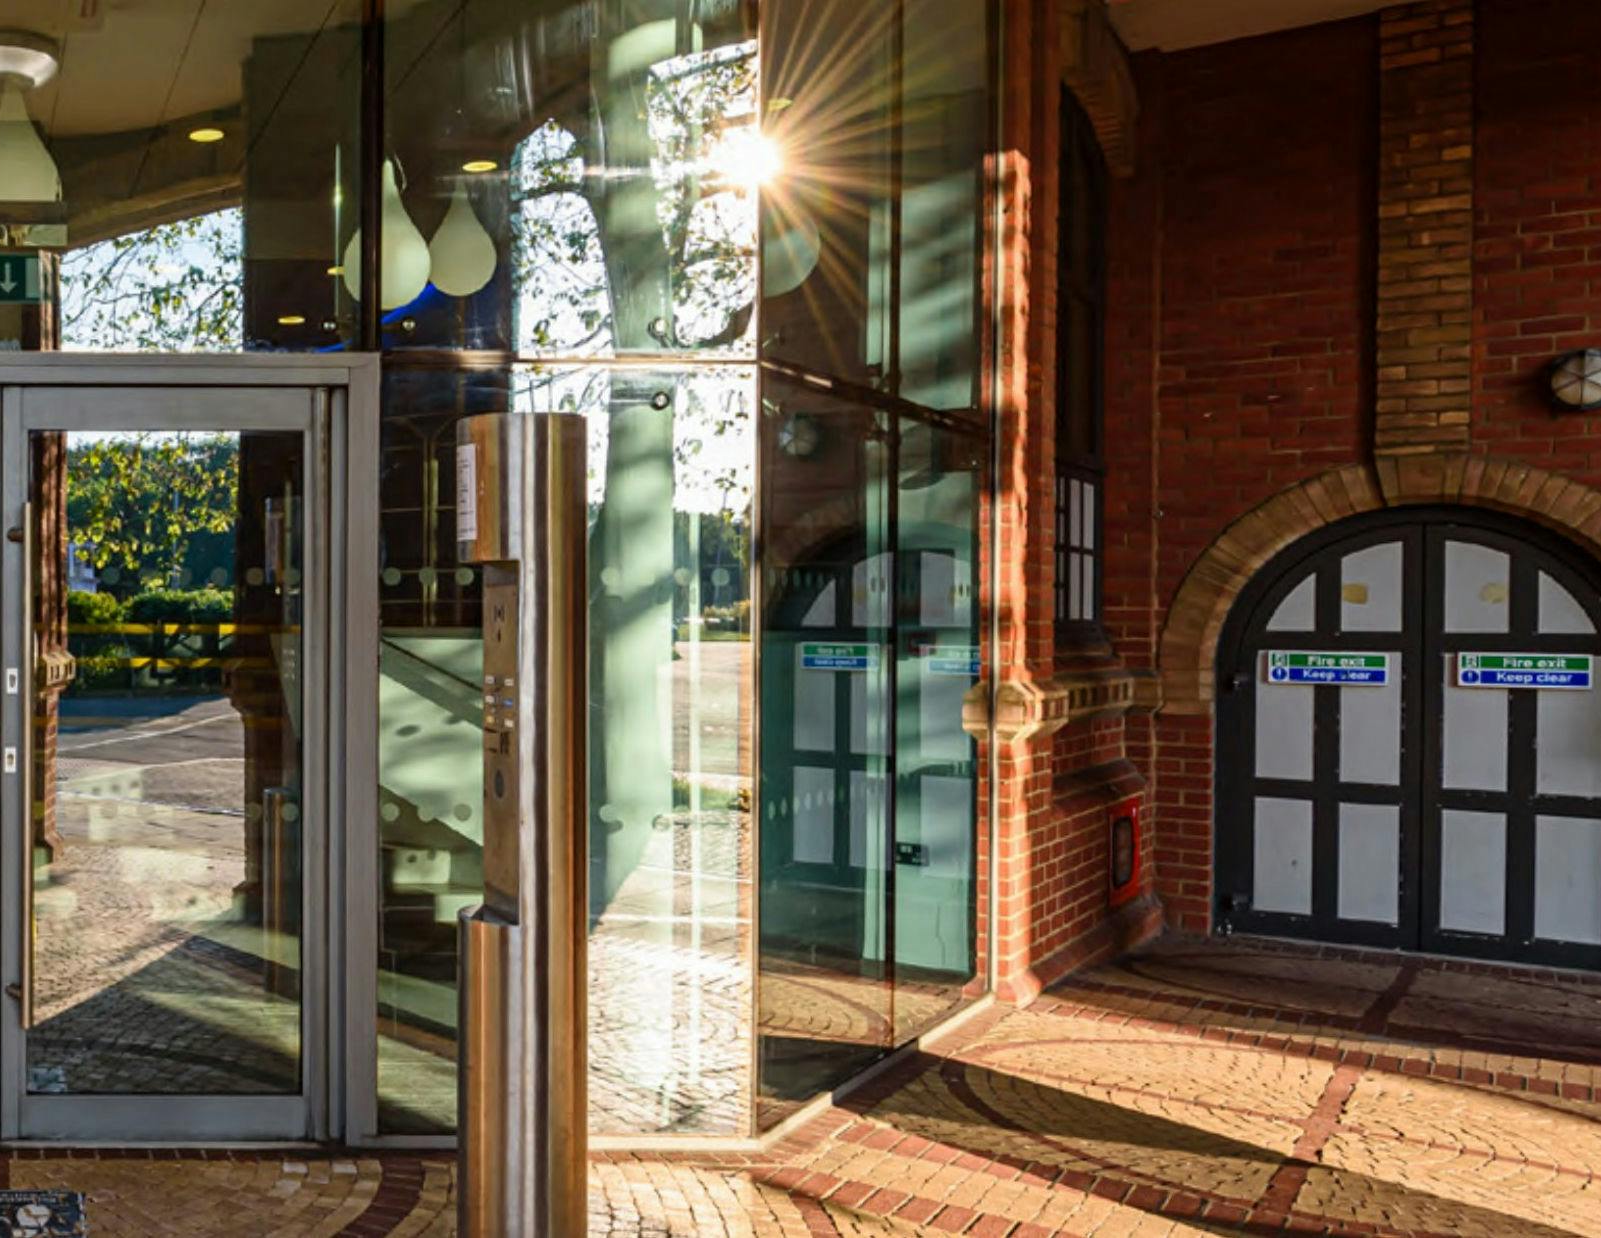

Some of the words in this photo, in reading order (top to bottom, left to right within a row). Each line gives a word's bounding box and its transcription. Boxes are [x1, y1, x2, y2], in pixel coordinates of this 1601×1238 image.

[1307, 655, 1335, 667] Fire
[1340, 657, 1365, 668] exit
[1503, 657, 1533, 667] Fire
[1537, 658, 1566, 668] exit
[1303, 669, 1335, 681] Keep
[1496, 672, 1533, 684] Keep
[1536, 673, 1573, 683] clear
